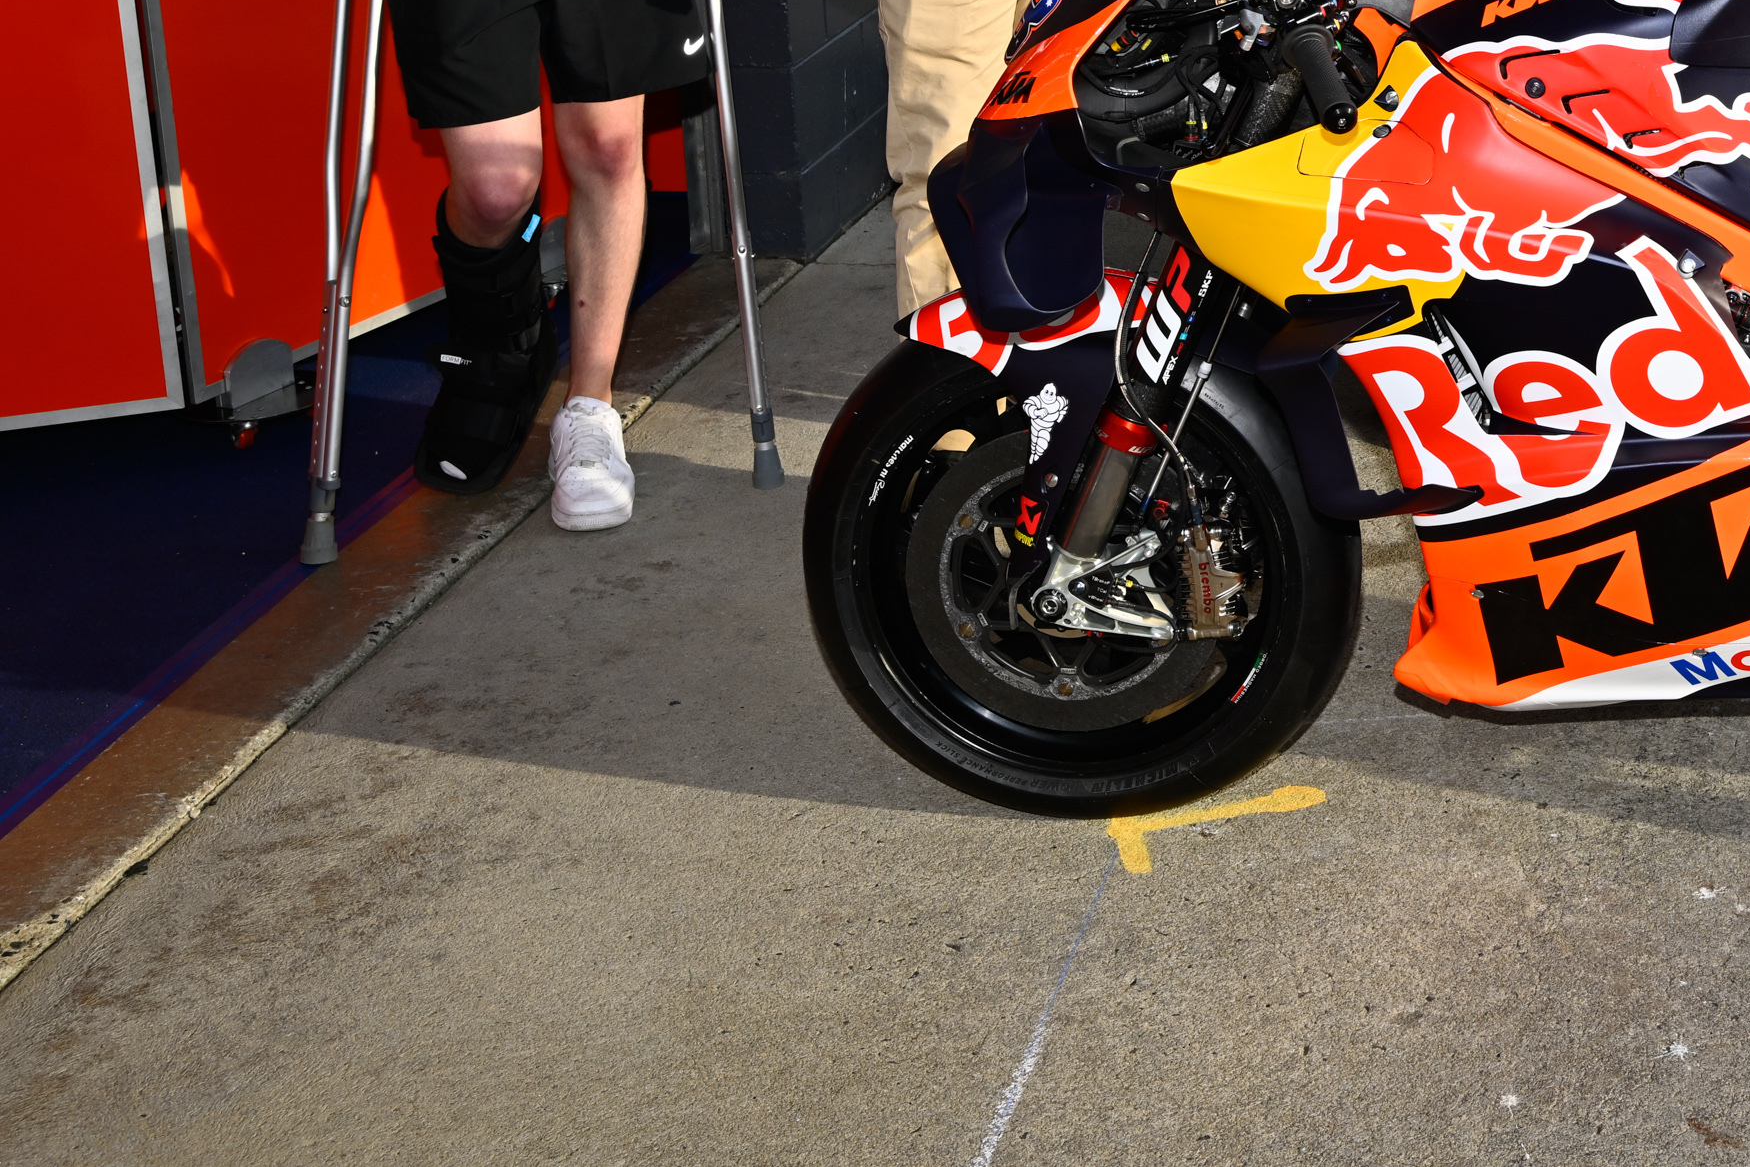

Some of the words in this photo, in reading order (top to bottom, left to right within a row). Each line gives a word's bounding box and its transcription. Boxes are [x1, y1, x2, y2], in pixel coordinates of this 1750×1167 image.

[990, 70, 1037, 107] KTM
[1198, 270, 1214, 298] SKF
[1136, 246, 1192, 384] WP
[1161, 355, 1179, 385] APEX
[1198, 562, 1216, 614] brembo
